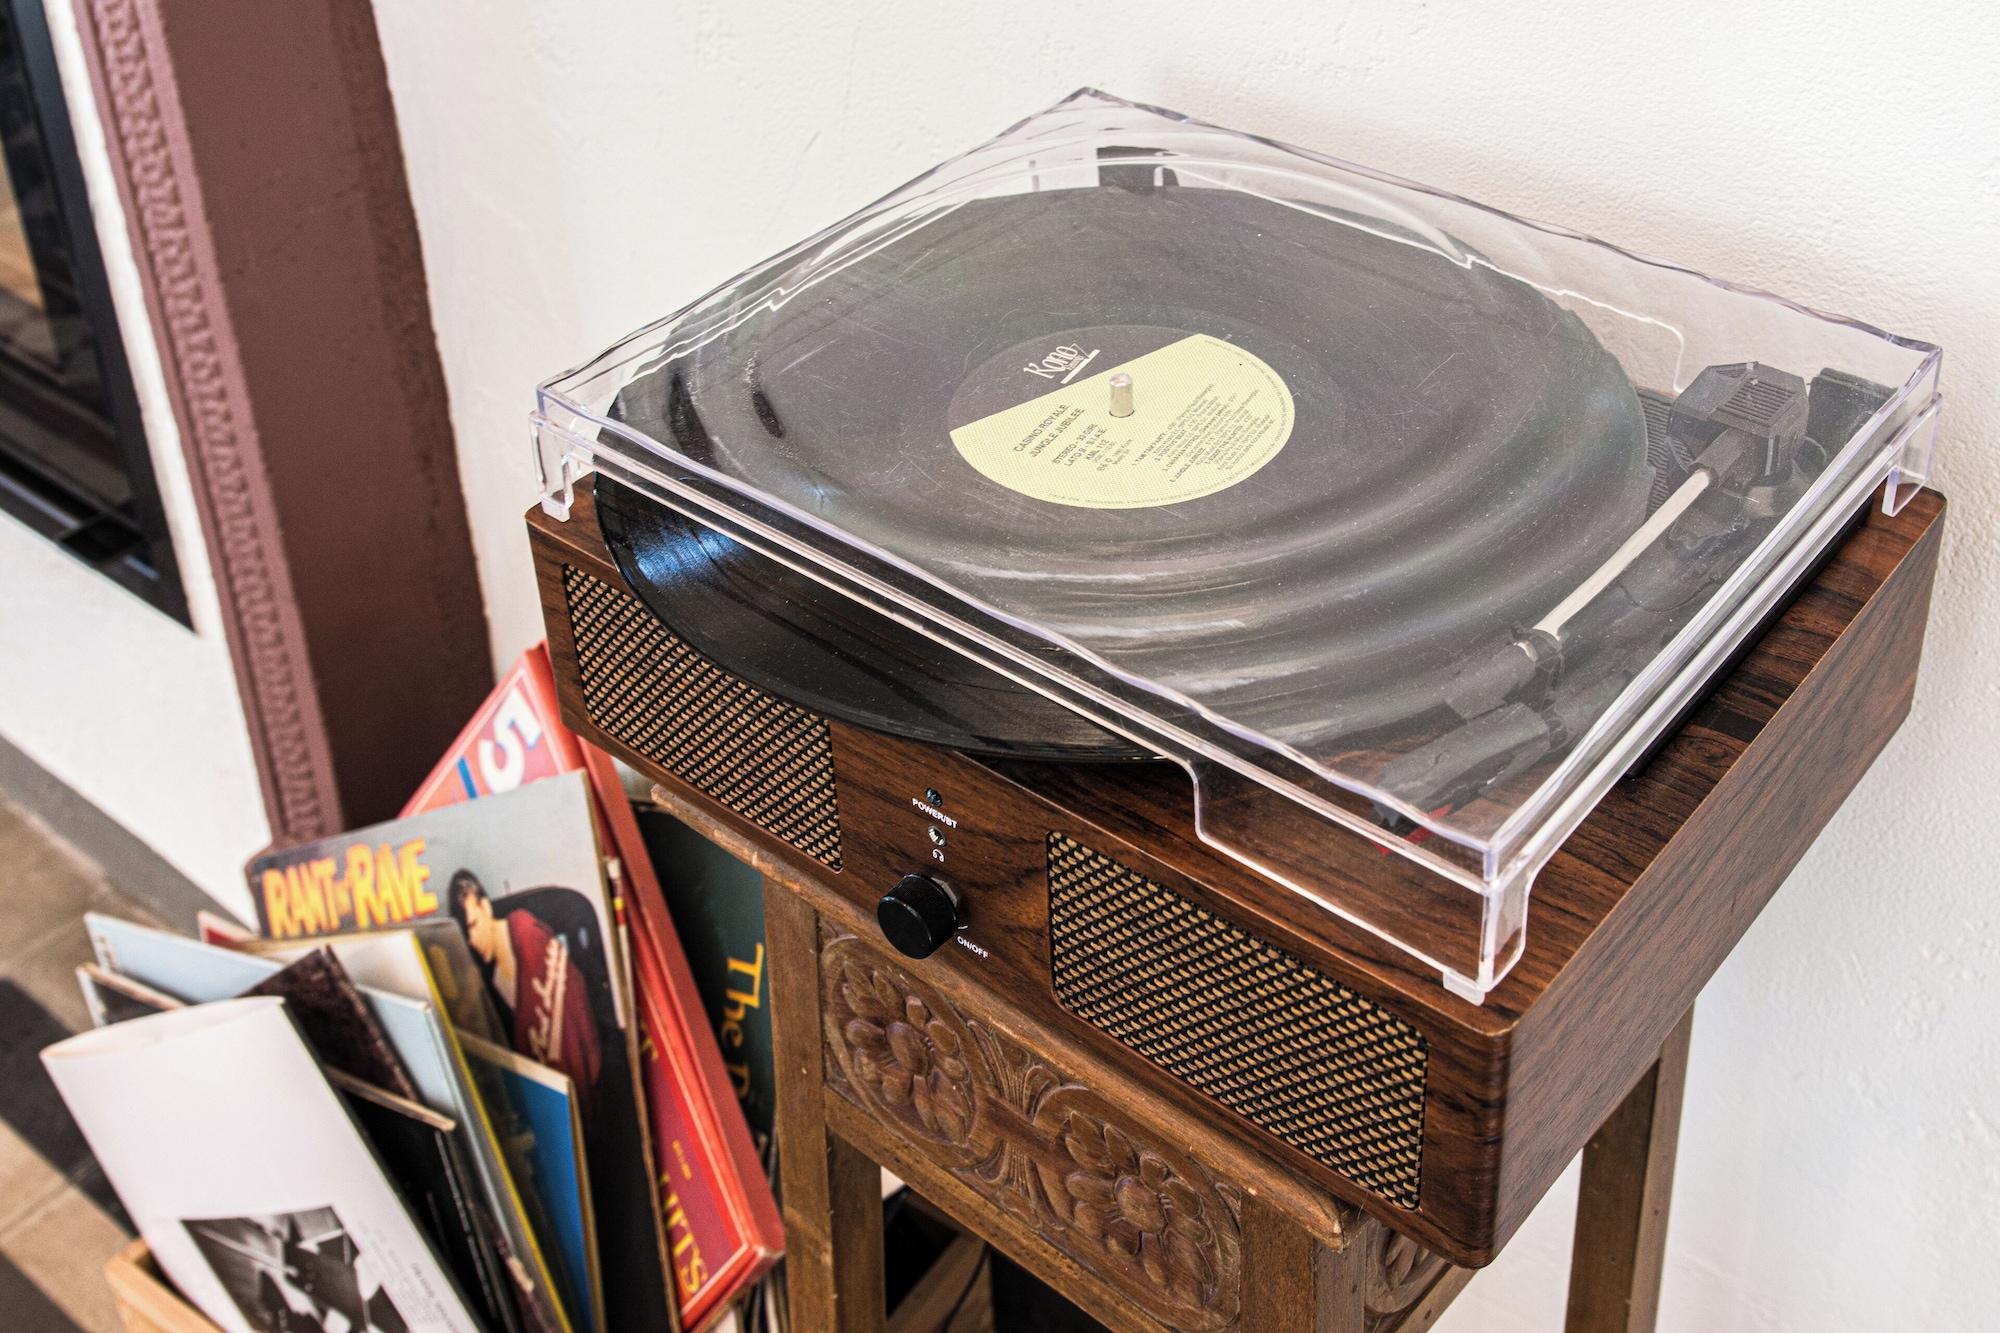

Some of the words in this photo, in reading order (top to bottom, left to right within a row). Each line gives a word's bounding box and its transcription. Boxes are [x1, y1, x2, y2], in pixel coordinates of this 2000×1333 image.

[1013, 428, 1043, 452] CASINO
[1038, 404, 1069, 431] ROYALE
[1030, 432, 1058, 458] JUNGLE
[1055, 408, 1085, 434] JUBILEE
[1052, 443, 1076, 464] STEREO
[912, 798, 958, 829] POWER/BT
[262, 856, 339, 939] RANT
[345, 837, 438, 929] RAVE
[957, 935, 989, 959] ON/OFF
[721, 942, 764, 1047] The
